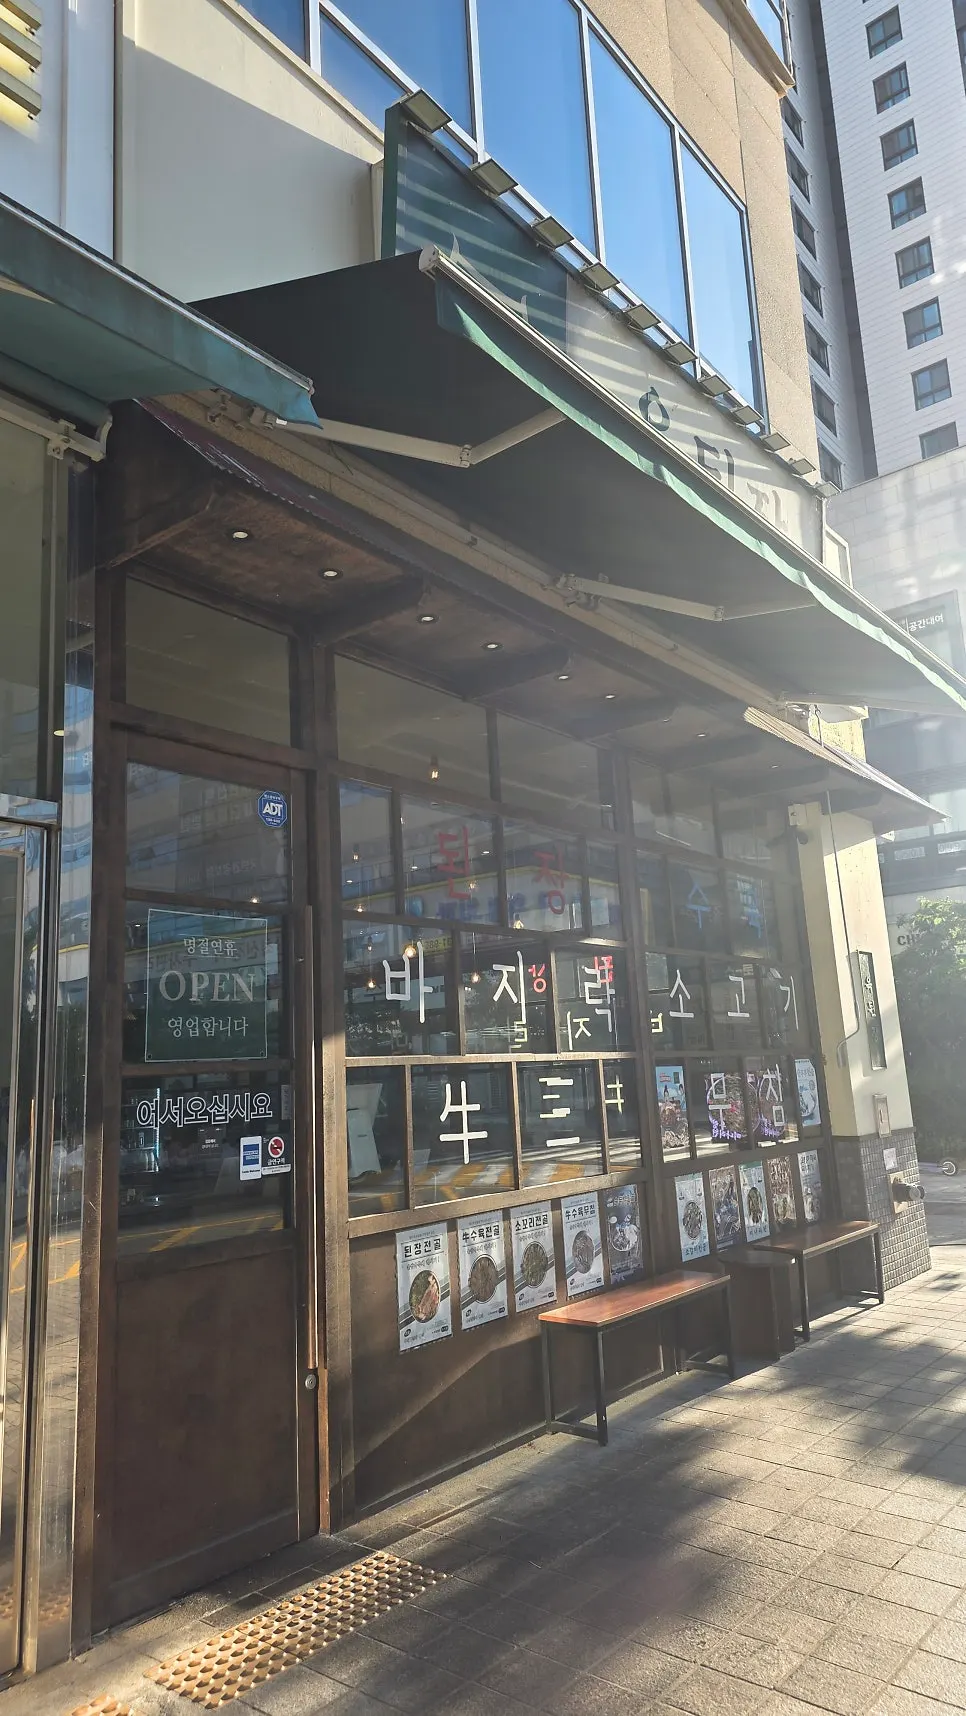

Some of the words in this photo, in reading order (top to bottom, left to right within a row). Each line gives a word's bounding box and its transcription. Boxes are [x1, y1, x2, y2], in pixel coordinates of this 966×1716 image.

[909, 613, 944, 632] 공간대여
[262, 801, 284, 817] ADT
[184, 937, 237, 956] 명절연휴
[159, 970, 255, 1002] OPEN
[668, 968, 799, 1031] 소고기
[168, 1017, 248, 1038] 영업합니다
[136, 1092, 273, 1129] 어서오십시요
[515, 1213, 549, 1232] 소꼬리전골
[404, 1237, 442, 1259] 된장전골
